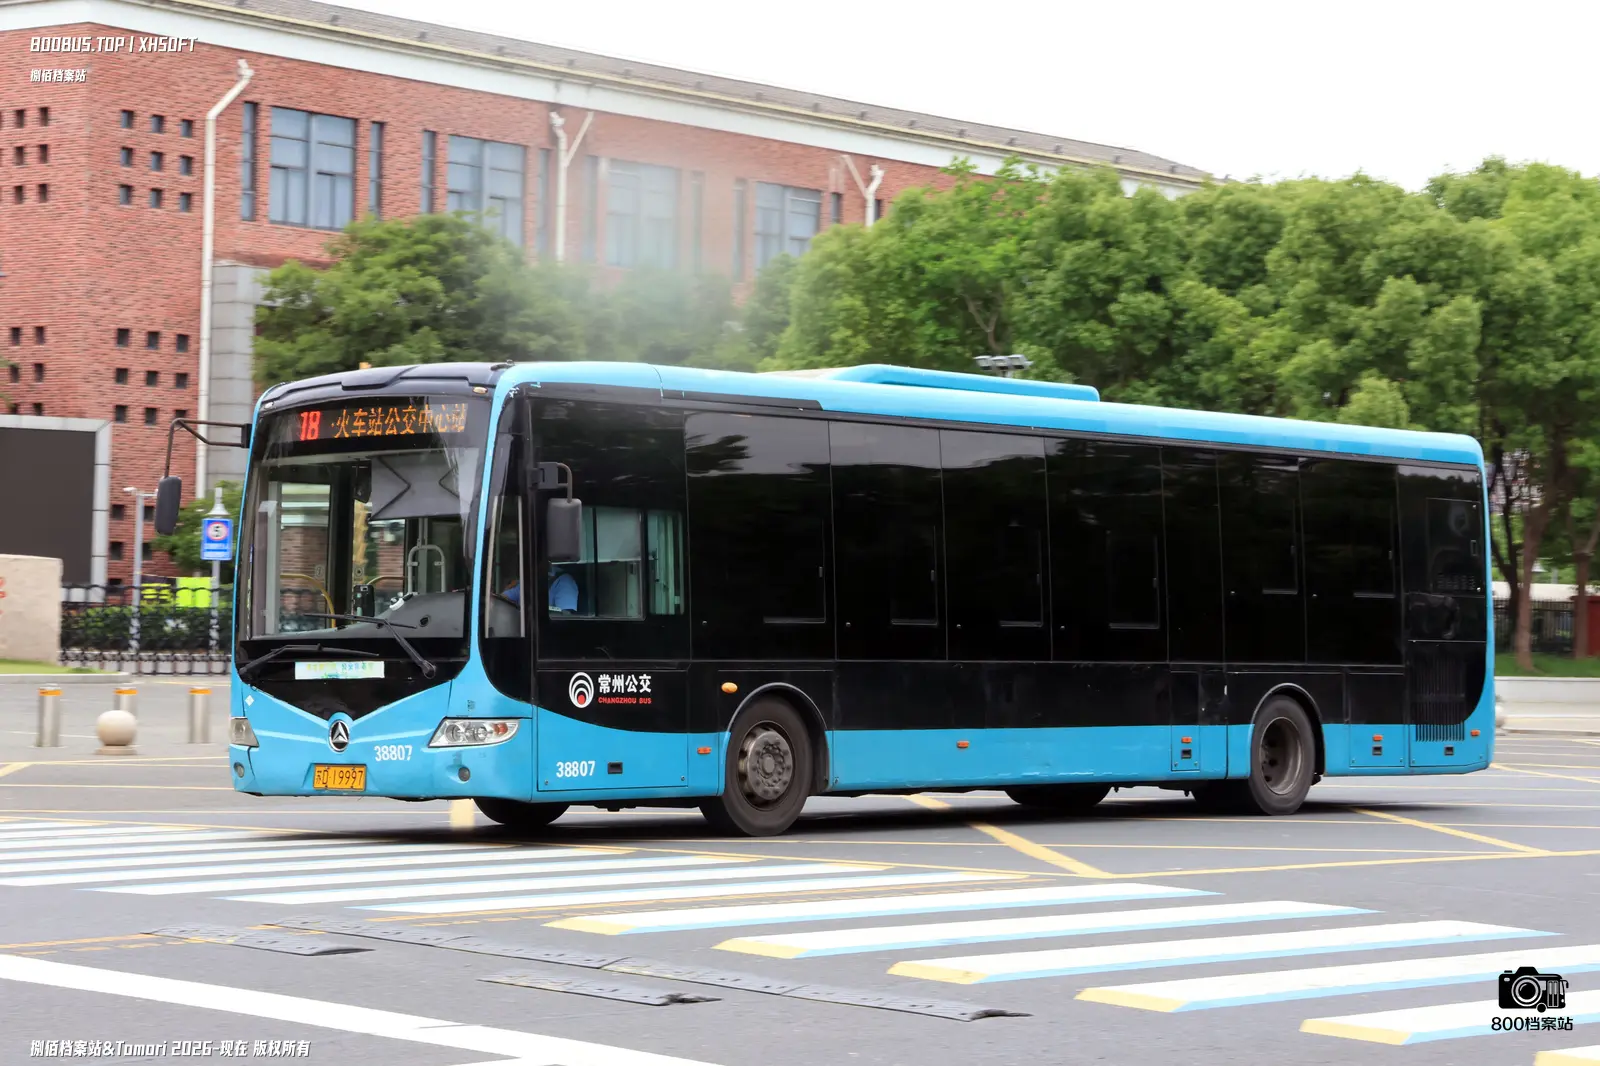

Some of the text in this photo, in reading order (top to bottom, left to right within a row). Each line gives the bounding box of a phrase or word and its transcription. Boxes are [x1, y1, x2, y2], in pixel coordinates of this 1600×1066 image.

[299, 411, 321, 441] 18
[331, 403, 467, 439] 火车站公交中心站
[598, 673, 652, 694] 常州公交
[374, 745, 413, 762] 38807
[556, 760, 596, 778] 38807
